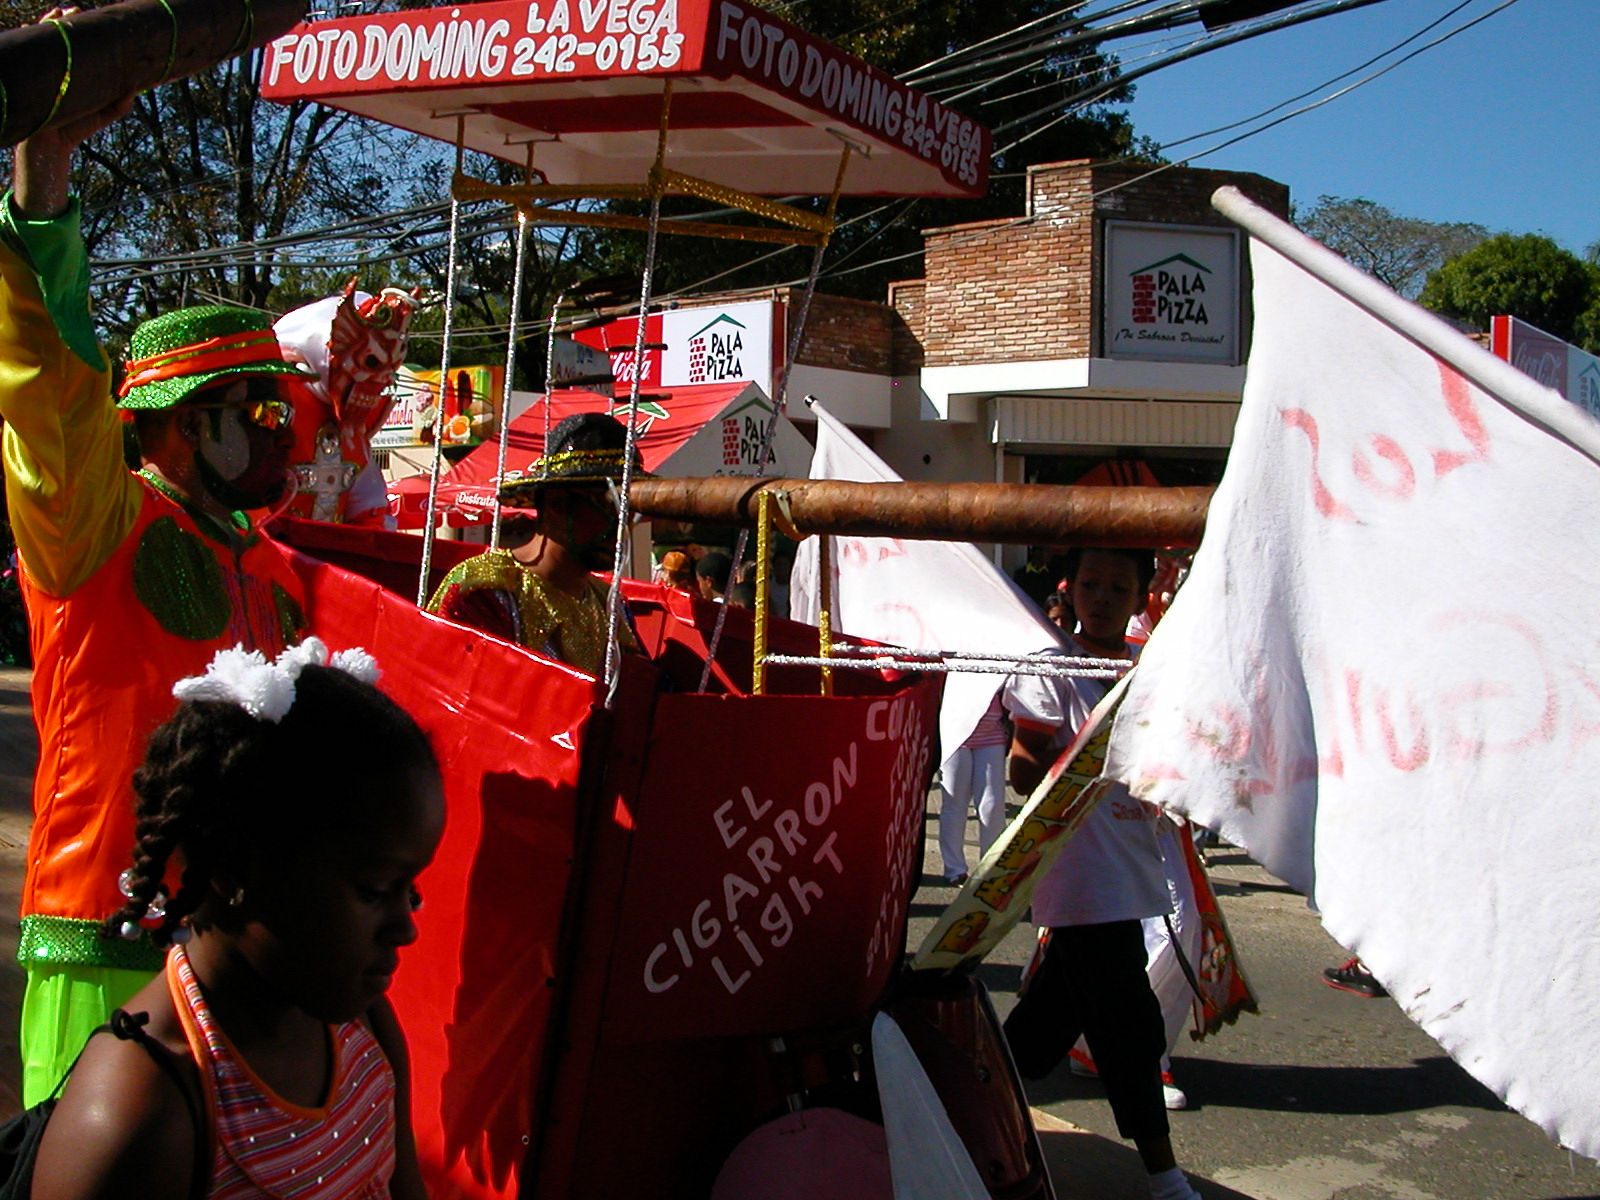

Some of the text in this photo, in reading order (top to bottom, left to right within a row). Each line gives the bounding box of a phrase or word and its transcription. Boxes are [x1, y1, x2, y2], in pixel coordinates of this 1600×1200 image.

[527, 0, 678, 35] LA VEGA
[716, 2, 800, 88] FOTO
[269, 29, 358, 87] FOTO
[511, 33, 686, 76] 242-0155
[902, 118, 979, 186] 242-0155
[905, 90, 982, 164] LA VEGA
[1158, 271, 1206, 296] PALA
[711, 330, 743, 357] PALA
[745, 416, 776, 441] PAL
[713, 786, 774, 849] EL
[643, 741, 858, 994] CIGARRON
